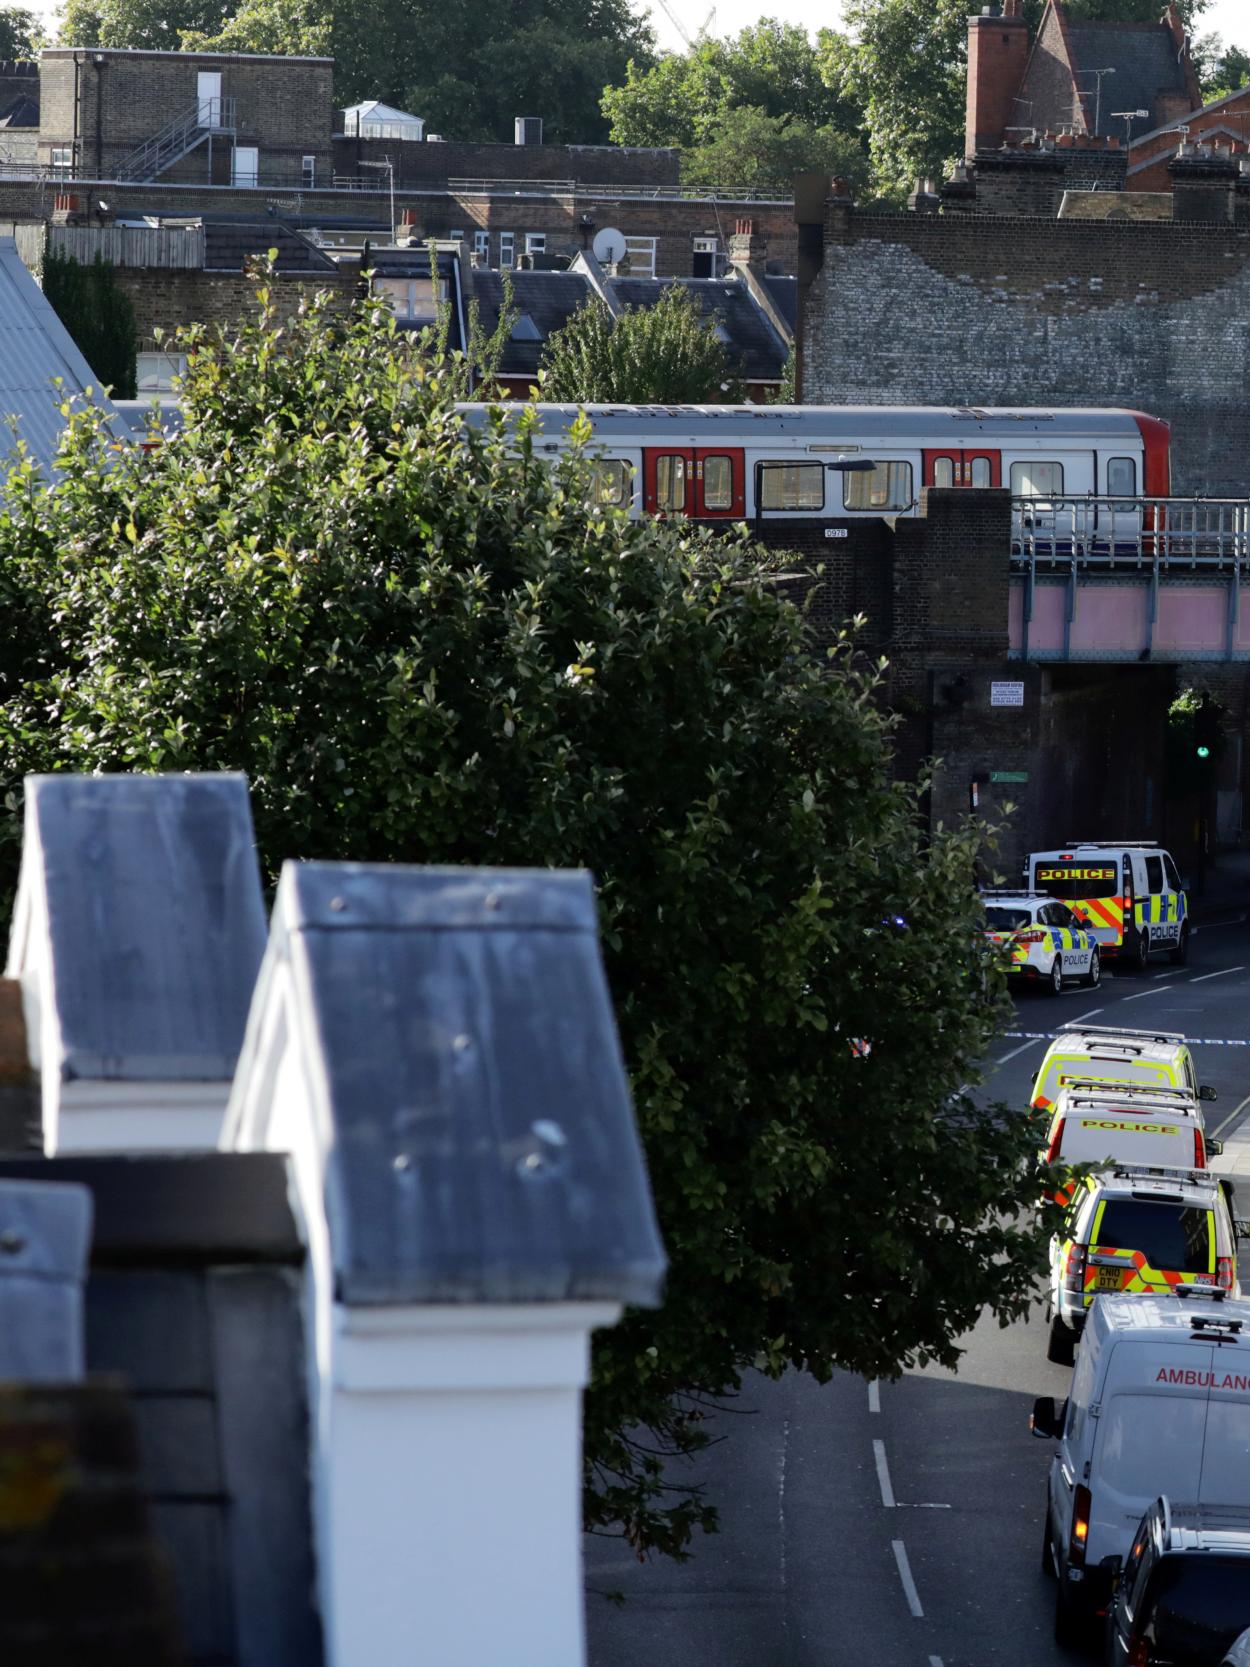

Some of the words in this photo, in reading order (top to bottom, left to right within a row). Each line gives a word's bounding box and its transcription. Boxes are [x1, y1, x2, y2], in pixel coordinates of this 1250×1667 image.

[1037, 869, 1115, 880] POLICE
[1151, 925, 1179, 938] POLICE
[1064, 953, 1089, 965] POLICE
[1082, 1120, 1176, 1134] POLICE
